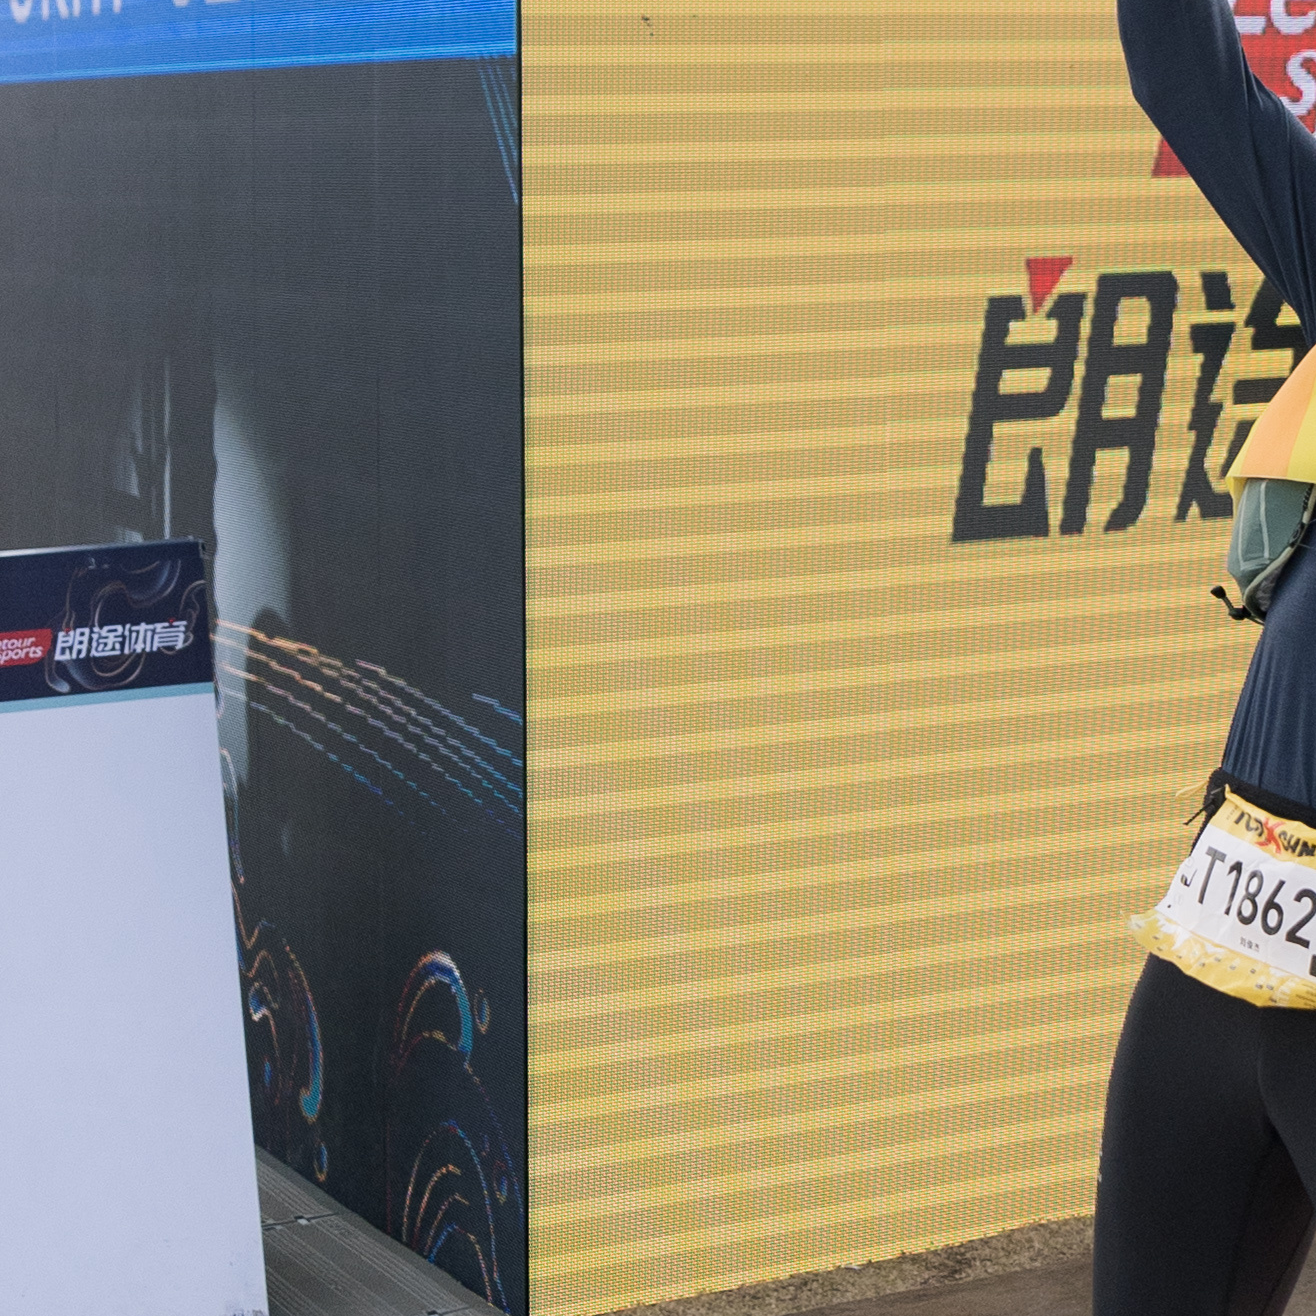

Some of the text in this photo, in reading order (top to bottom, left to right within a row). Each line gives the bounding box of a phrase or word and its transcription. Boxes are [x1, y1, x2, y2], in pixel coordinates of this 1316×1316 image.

[0, 637, 35, 650] tour
[54, 618, 188, 661] 朗途体育
